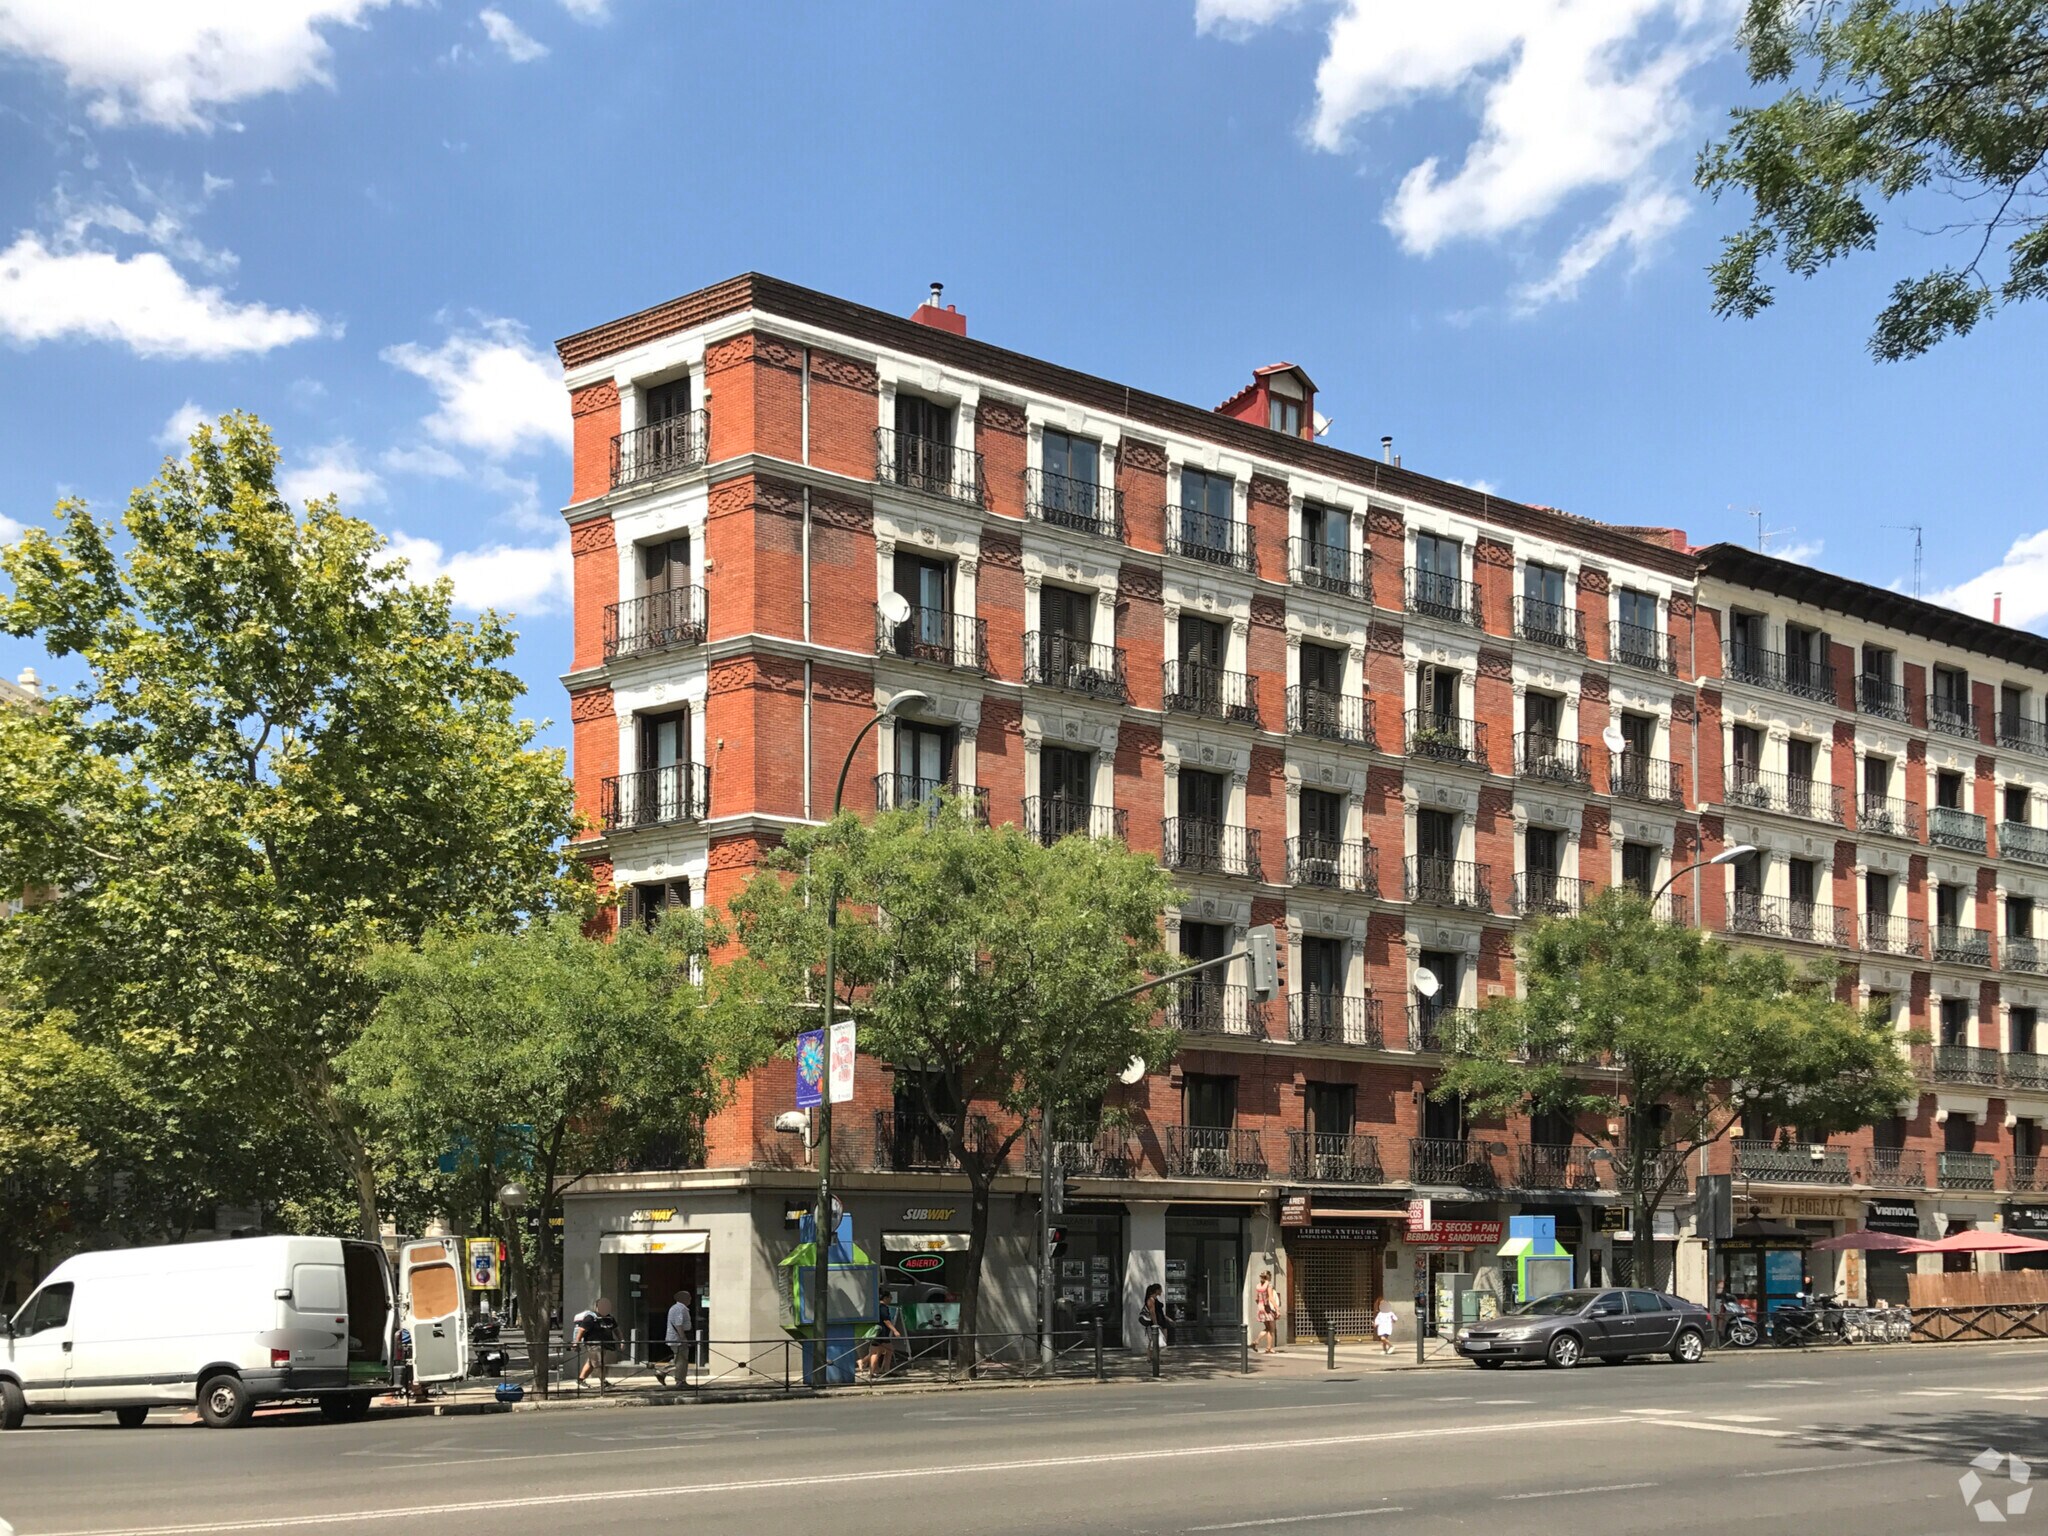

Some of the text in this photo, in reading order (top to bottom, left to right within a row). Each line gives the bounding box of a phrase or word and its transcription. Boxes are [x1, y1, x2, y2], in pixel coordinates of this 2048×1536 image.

[630, 1207, 678, 1222] SUBWAY
[903, 1208, 955, 1220] SUBWAY
[1445, 1223, 1473, 1232] SECOS
[1481, 1223, 1500, 1232] PAN
[1406, 1232, 1499, 1242] BEBIDAS SANDWICHES
[905, 1259, 939, 1268] ABIERTO
